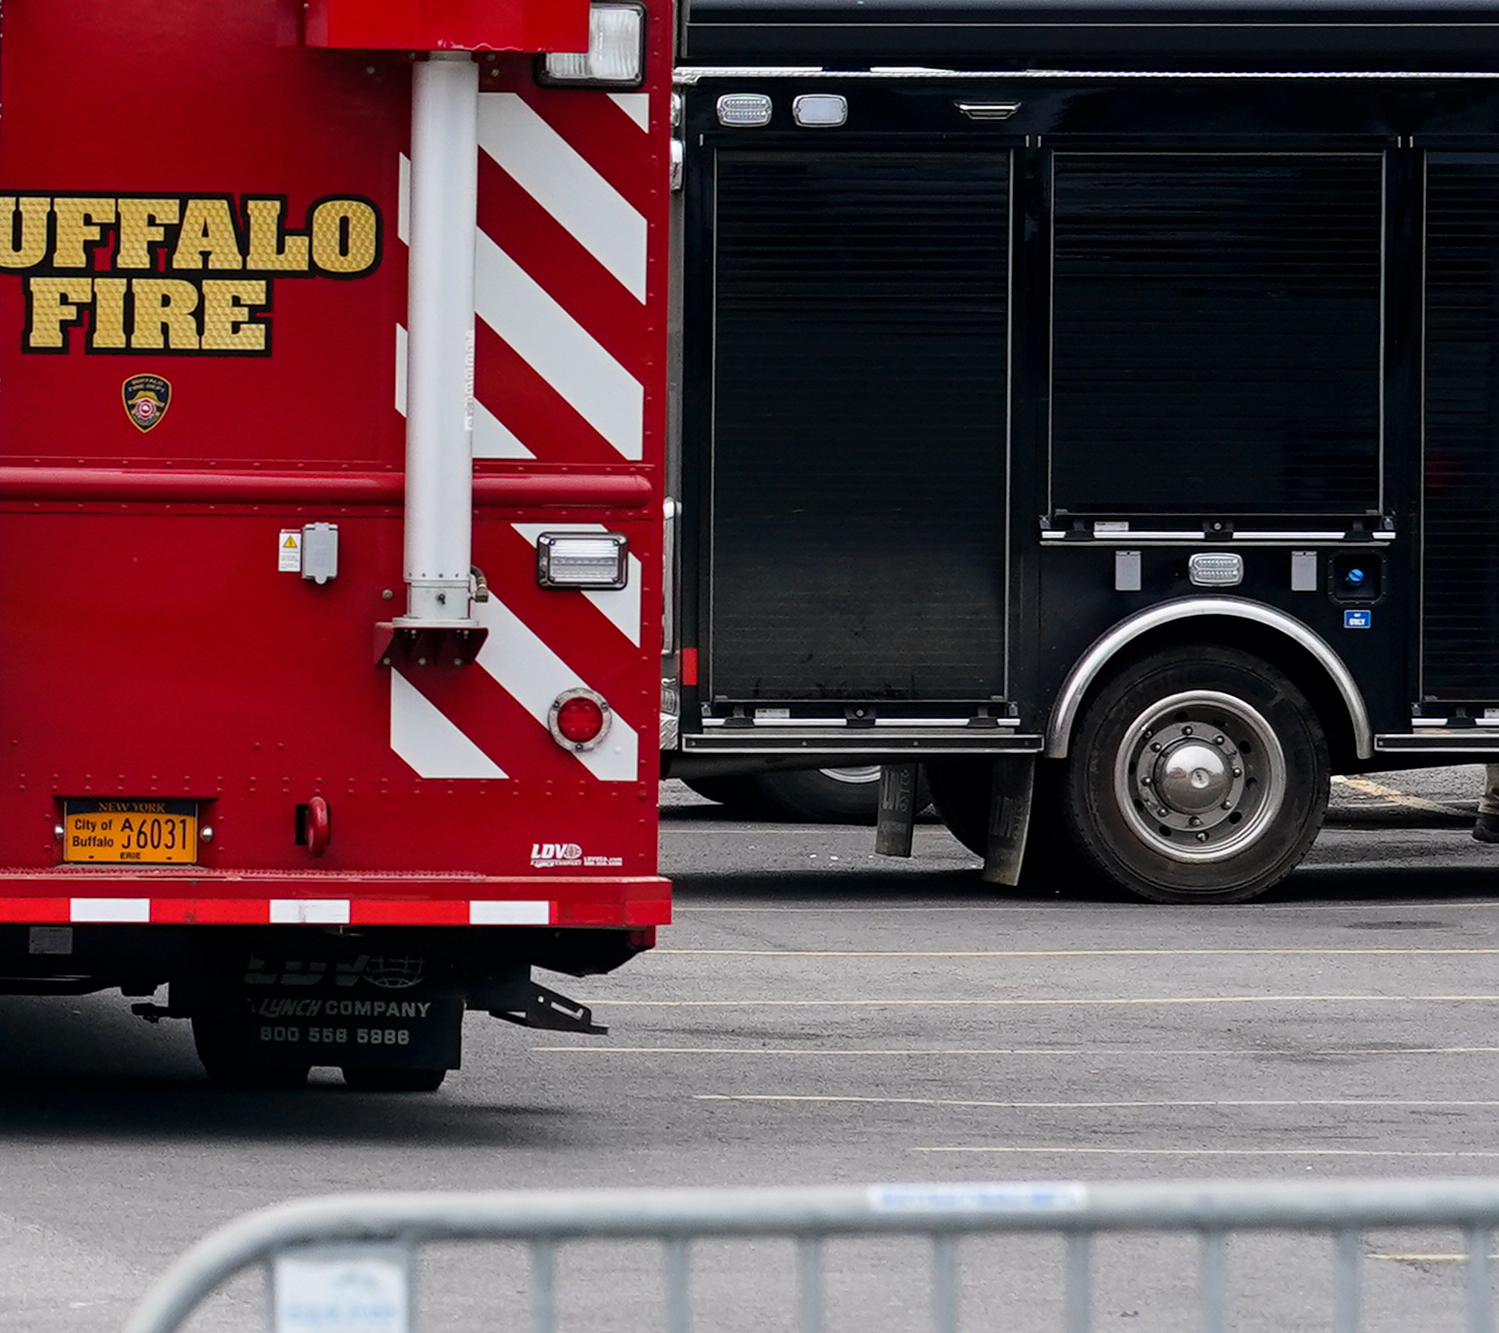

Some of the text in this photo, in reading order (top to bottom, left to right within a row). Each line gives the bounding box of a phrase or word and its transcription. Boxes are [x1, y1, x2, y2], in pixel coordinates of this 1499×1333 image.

[29, 276, 268, 351] FIRE
[98, 802, 166, 813] NEW YORK
[74, 817, 186, 849] City of A 6031
[72, 835, 131, 849] Buffalo J
[530, 843, 568, 859] LDV
[258, 998, 432, 1018] LYNCH COMPANY
[260, 1026, 300, 1042] 800
